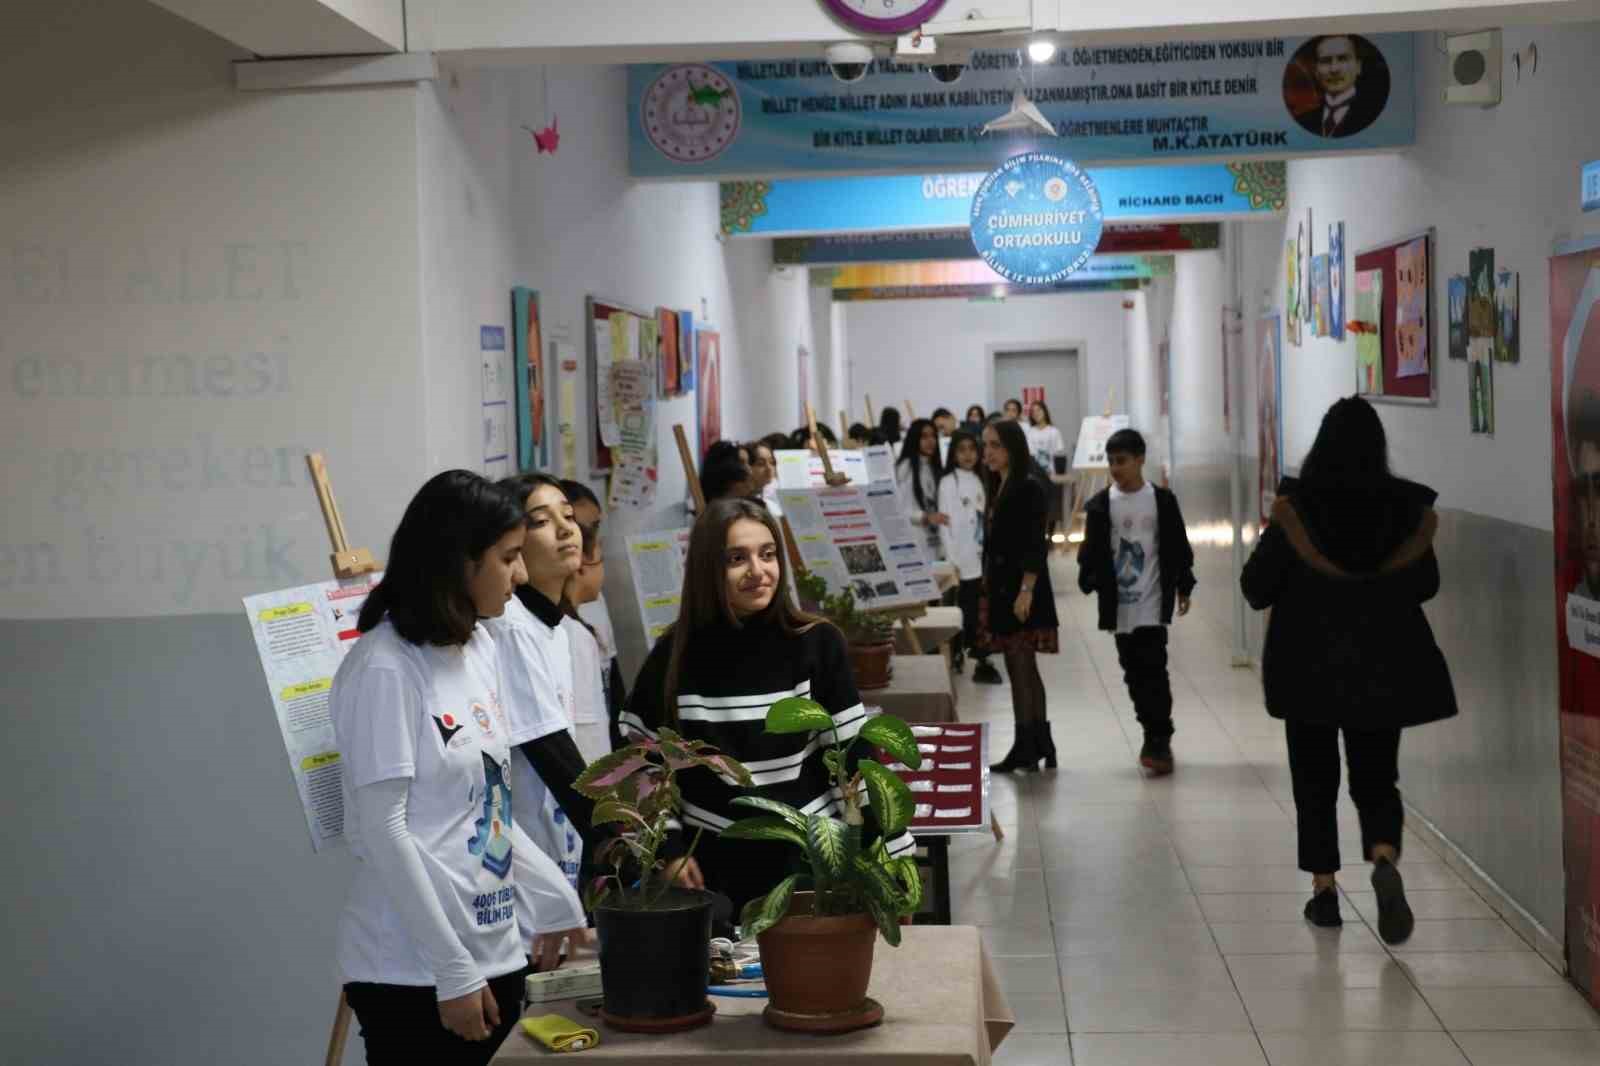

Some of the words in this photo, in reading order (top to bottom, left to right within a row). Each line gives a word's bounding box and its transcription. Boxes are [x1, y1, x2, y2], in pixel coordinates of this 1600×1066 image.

[1219, 40, 1264, 58] YOKSUN
[1266, 37, 1284, 57] BİR
[762, 95, 798, 113] MİLLET
[801, 94, 837, 112] HENÜZ
[839, 93, 876, 111] MİLLET
[880, 92, 907, 110] ADINI
[910, 91, 945, 109] ALMAK
[1136, 79, 1167, 99] BASİT
[1170, 77, 1188, 97] BİR
[1191, 76, 1221, 96] KİTLE
[1224, 74, 1257, 94] DENİR
[813, 127, 832, 147] BİR
[834, 127, 864, 146] KİTLE
[866, 124, 902, 145] MİLLET
[905, 124, 965, 144] OLABİLMEK
[1146, 115, 1208, 134] MUHTAÇTIR
[1119, 194, 1182, 209] RİCHARD
[1186, 193, 1224, 206] BACH
[987, 208, 1086, 229] CUMHURİYET
[992, 231, 1081, 249] ORTAOKULU
